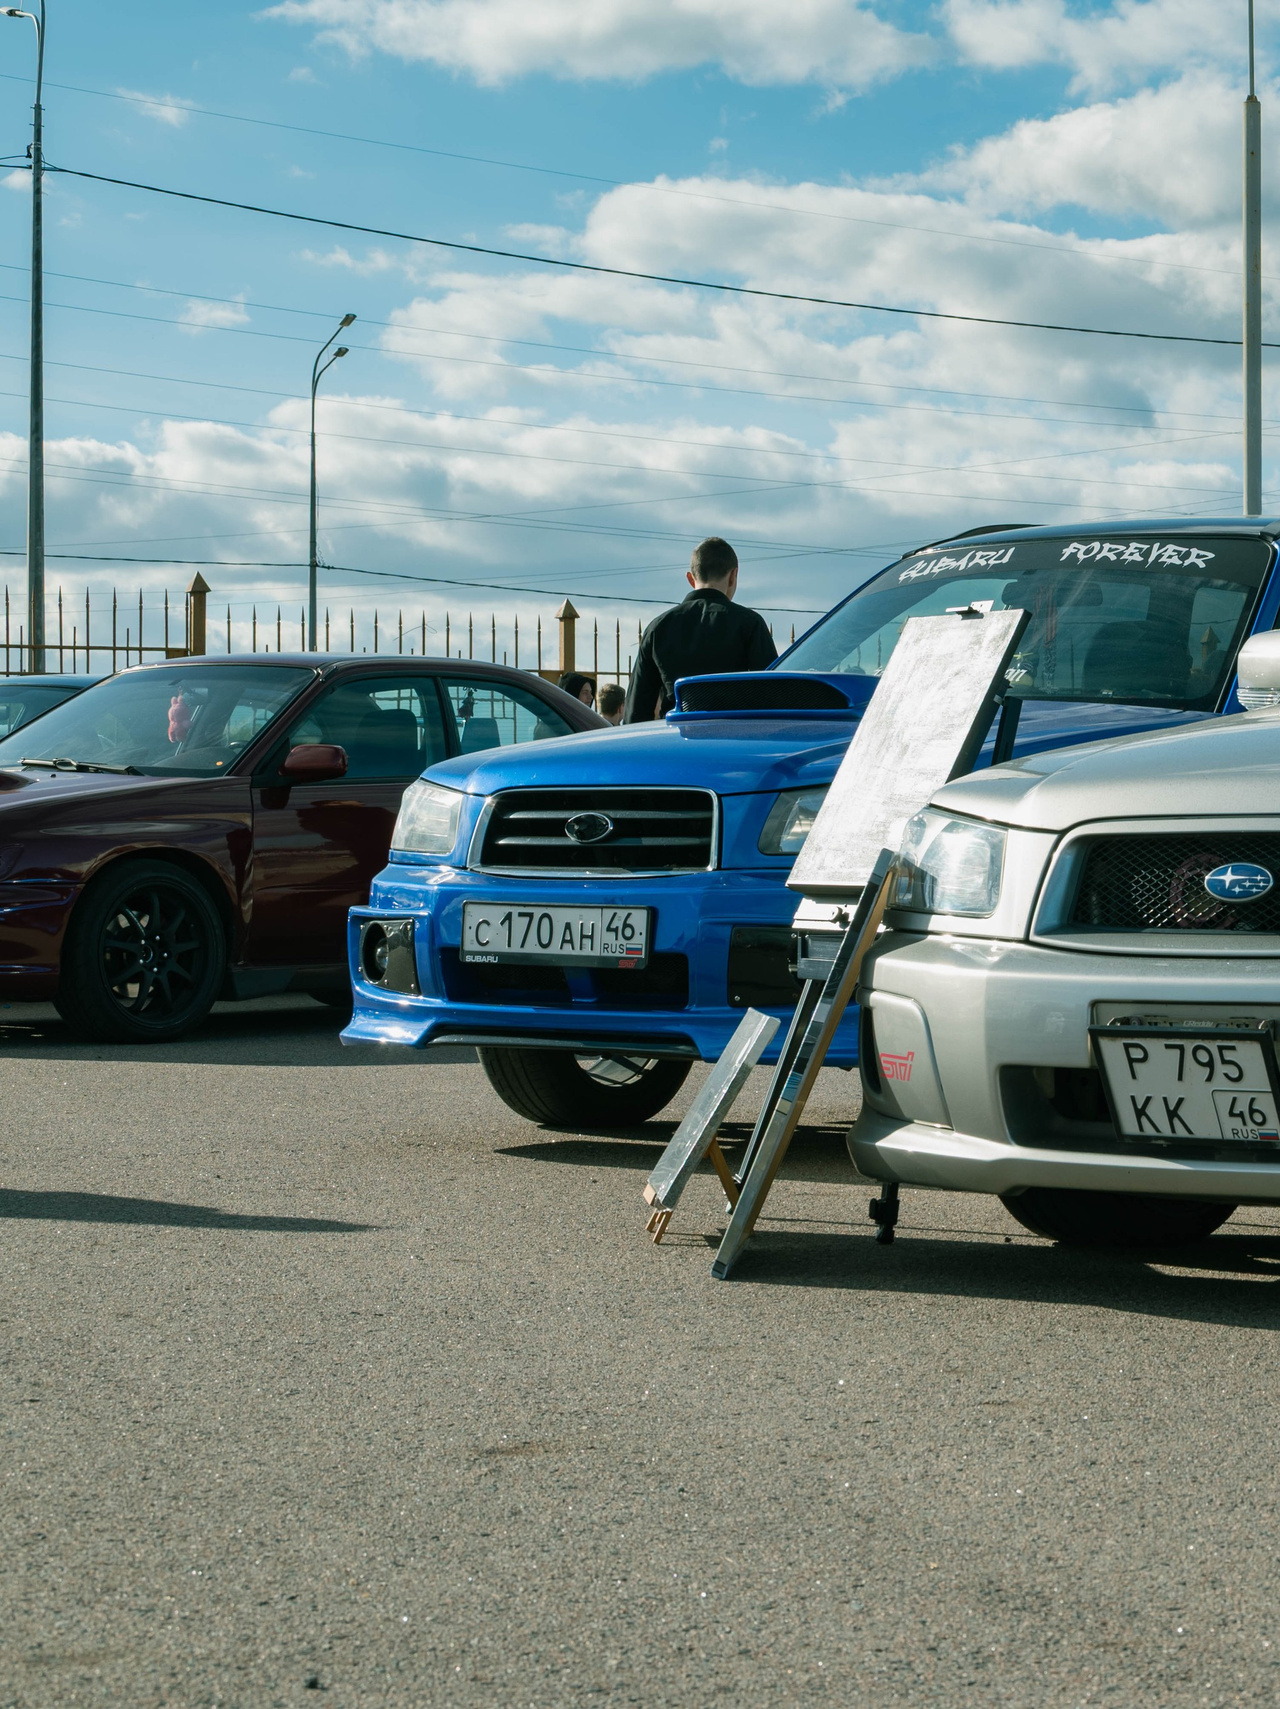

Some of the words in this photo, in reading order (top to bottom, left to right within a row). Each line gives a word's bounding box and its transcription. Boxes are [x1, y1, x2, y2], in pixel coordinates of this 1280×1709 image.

[899, 547, 1015, 583] SUBARU
[1060, 541, 1215, 568] FOREVER
[606, 912, 635, 941] 46
[603, 943, 625, 954] RUS
[465, 955, 498, 963] SUBARU
[1228, 1096, 1267, 1127] 46
[1232, 1128, 1258, 1140] RUS
